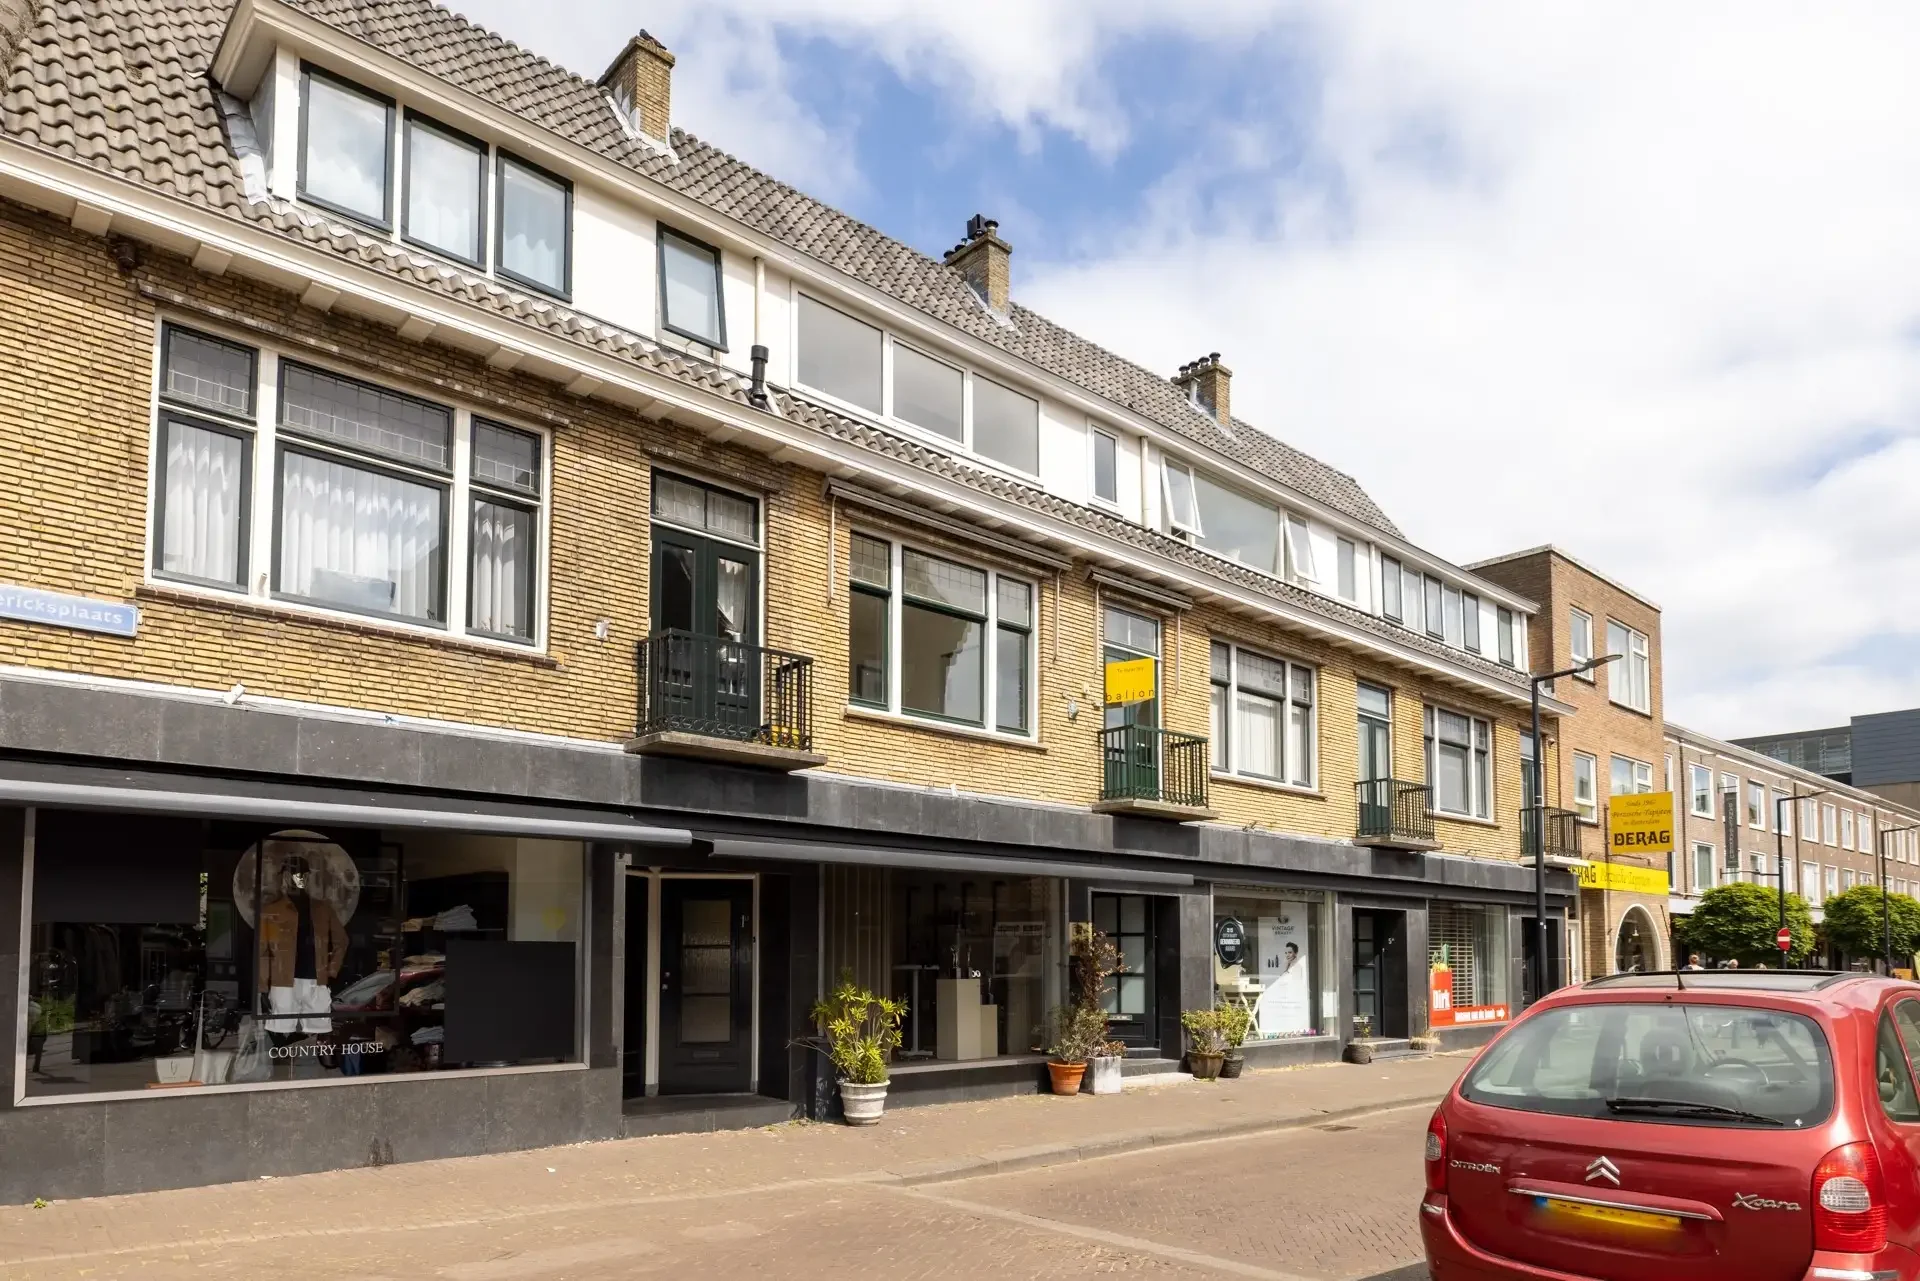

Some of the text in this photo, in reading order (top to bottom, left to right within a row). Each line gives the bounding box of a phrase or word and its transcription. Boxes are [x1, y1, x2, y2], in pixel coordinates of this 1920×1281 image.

[1105, 689, 1154, 701] baljon
[1433, 989, 1450, 1010] Dirk
[268, 1042, 384, 1059] COUNTRY HOUSE
[1731, 1192, 1802, 1210] Xsara
